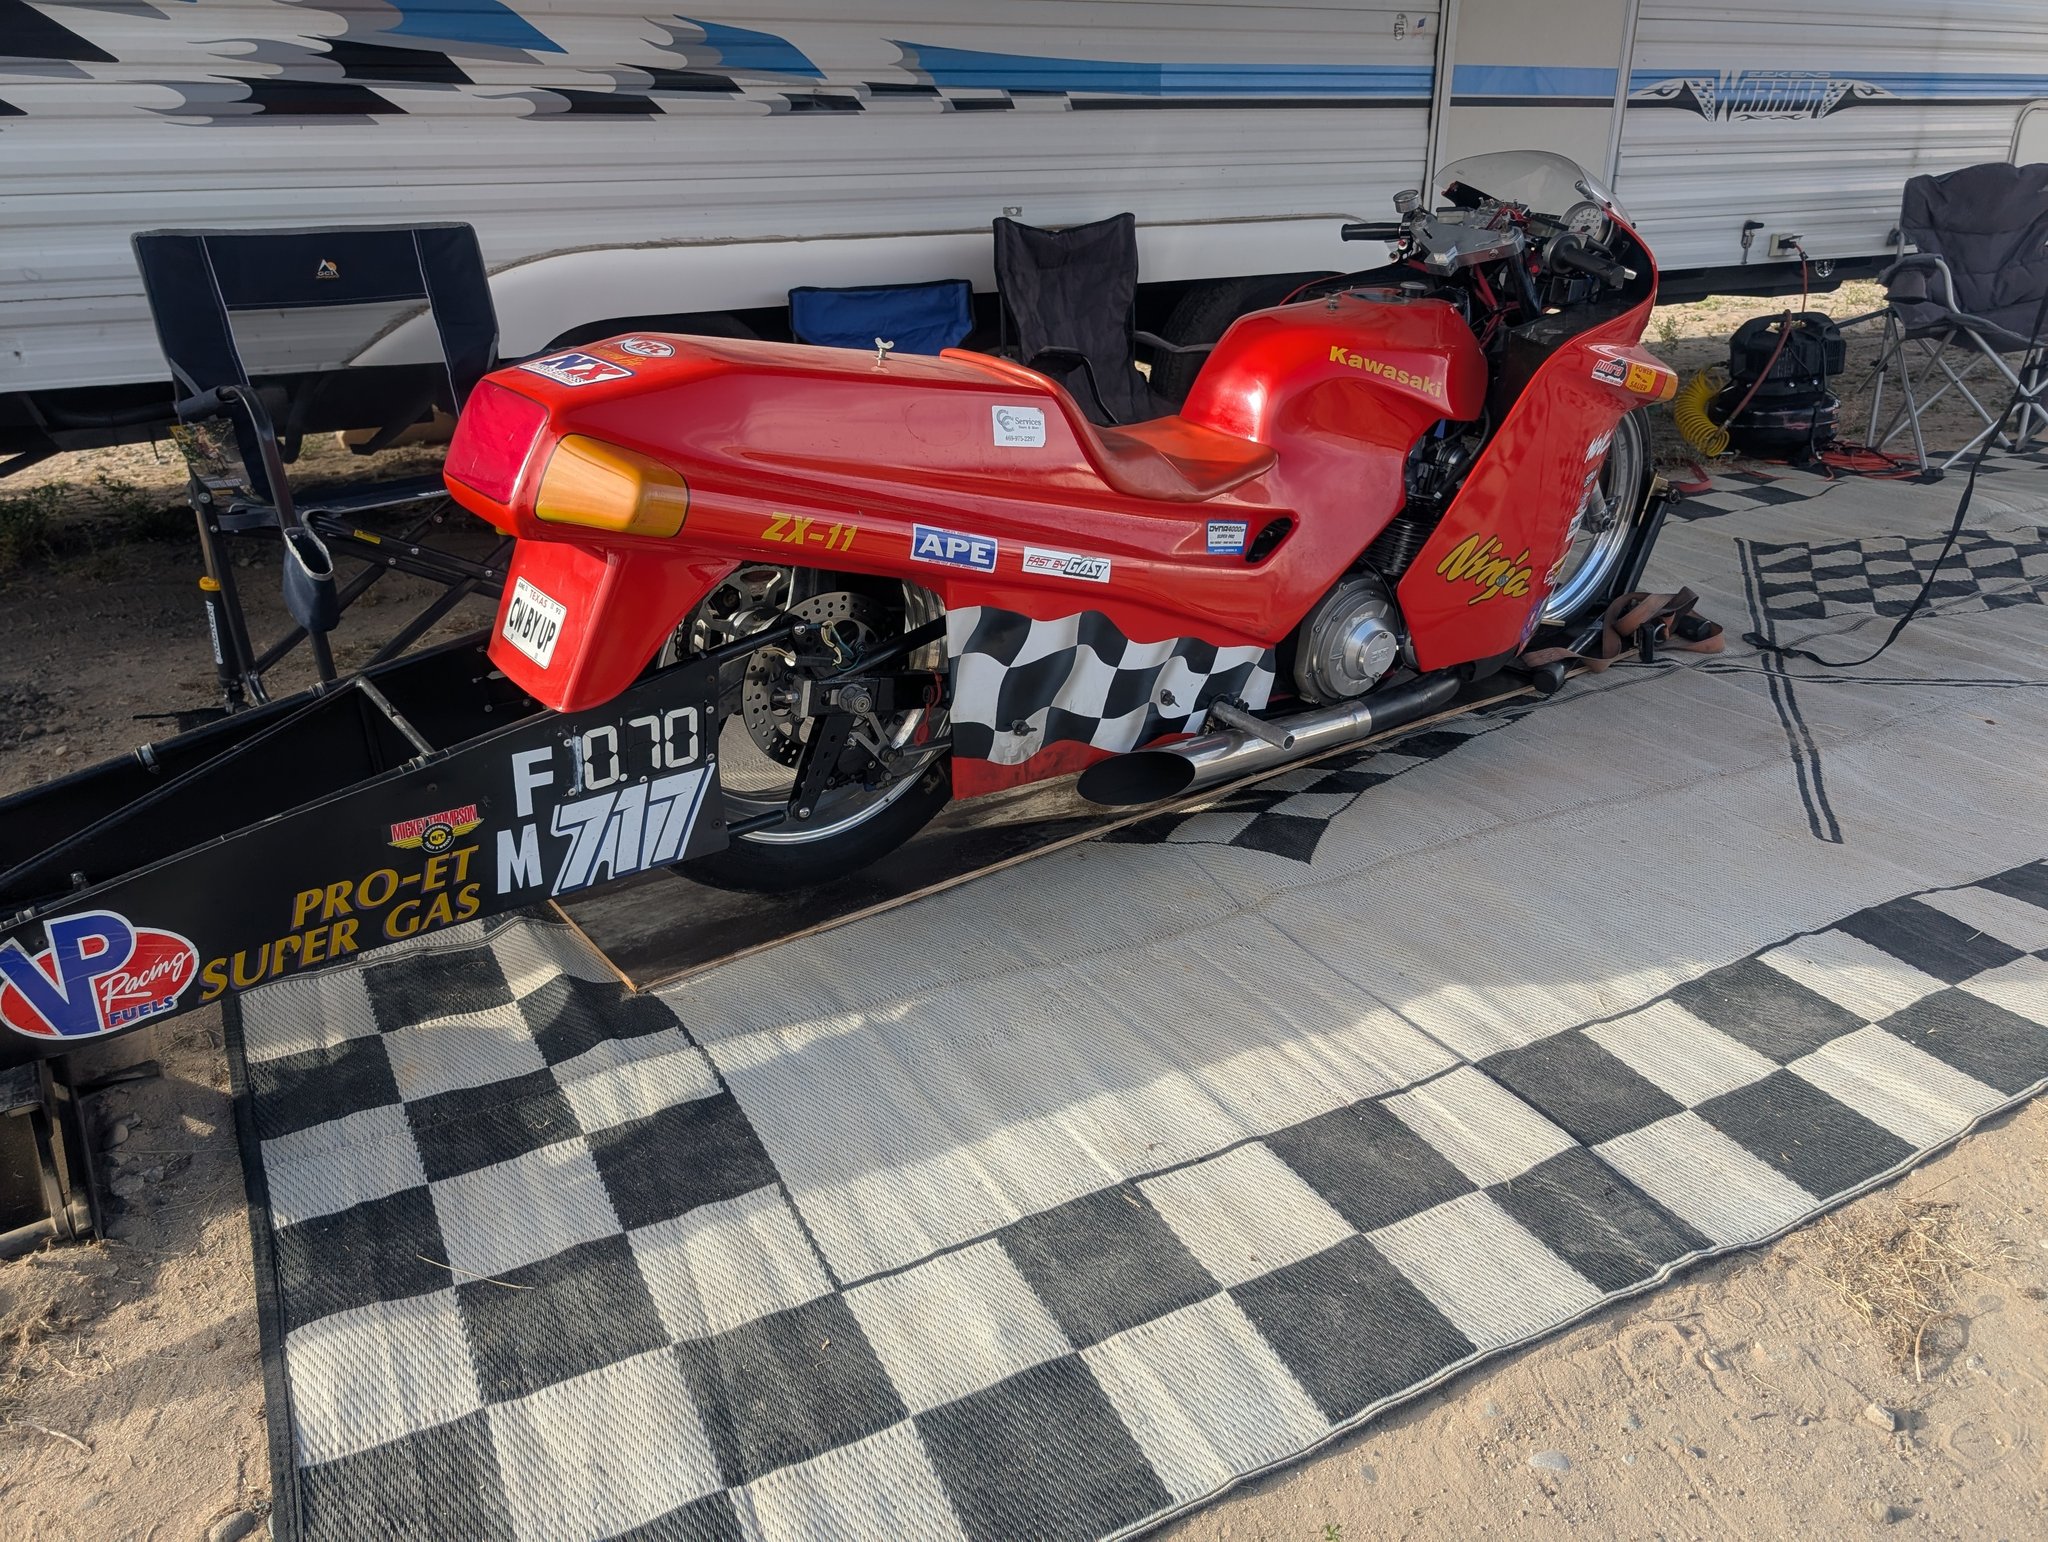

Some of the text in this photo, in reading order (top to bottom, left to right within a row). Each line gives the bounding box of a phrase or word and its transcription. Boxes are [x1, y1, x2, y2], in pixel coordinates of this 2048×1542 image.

[539, 354, 628, 381] NX
[1329, 345, 1442, 398] Kawasaki
[1014, 416, 1042, 427] Services
[761, 511, 859, 552] ZX-11
[917, 533, 991, 565] APE
[1026, 556, 1109, 579] FAST BY GAST
[1436, 533, 1532, 606] Ninja
[530, 589, 548, 608] TEXAS
[522, 607, 542, 643] BY
[537, 617, 556, 653] UP
[512, 746, 554, 818] F
[391, 804, 478, 842] MICKEY THOMPSON
[497, 763, 716, 896] M 717
[291, 845, 480, 931] PRO-ET
[200, 883, 481, 1002] SUPER GAS
[0, 911, 135, 1037] VP
[100, 951, 193, 1014] Racing
[109, 995, 175, 1026] FUELS
